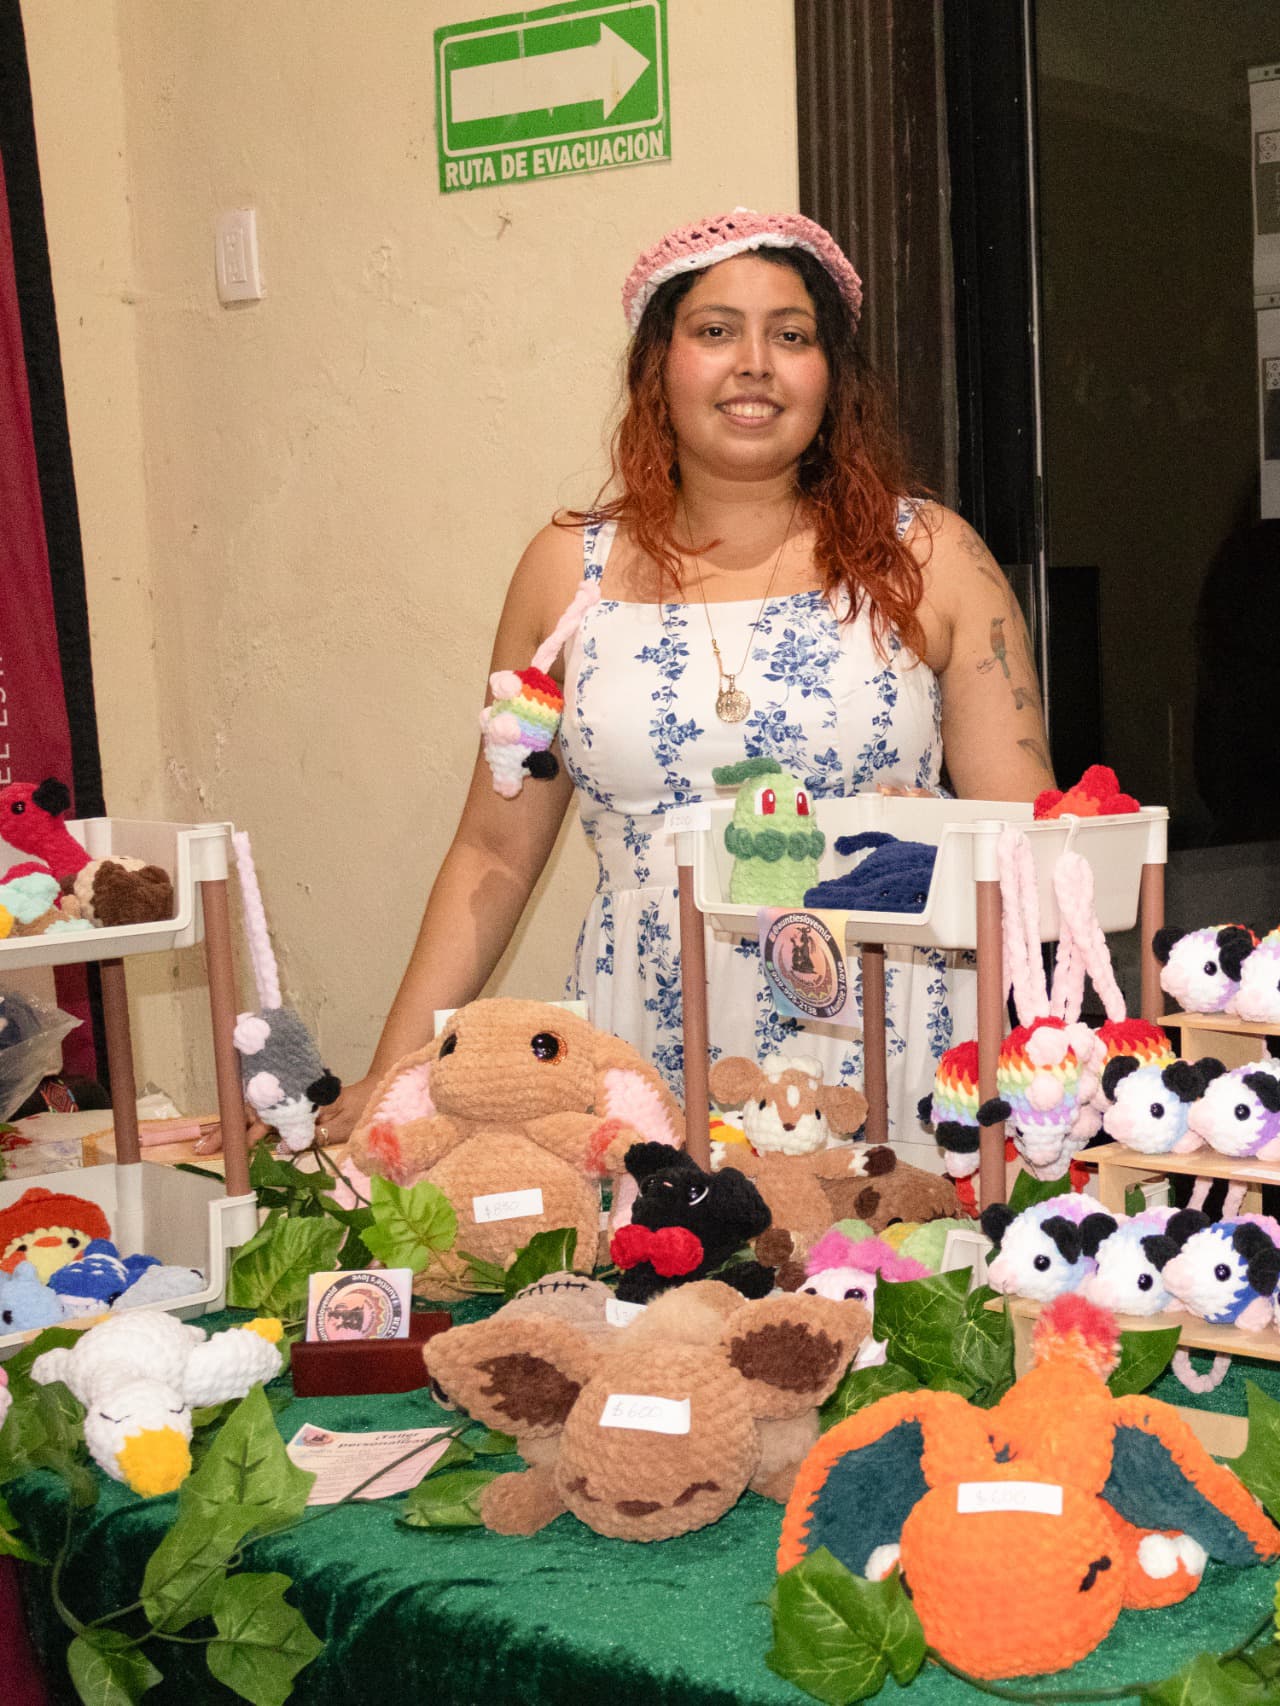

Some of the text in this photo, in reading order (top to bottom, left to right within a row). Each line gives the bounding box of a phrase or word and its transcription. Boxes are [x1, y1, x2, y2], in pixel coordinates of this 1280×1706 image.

[444, 127, 666, 188] RUTA DE EVACUACIÓN
